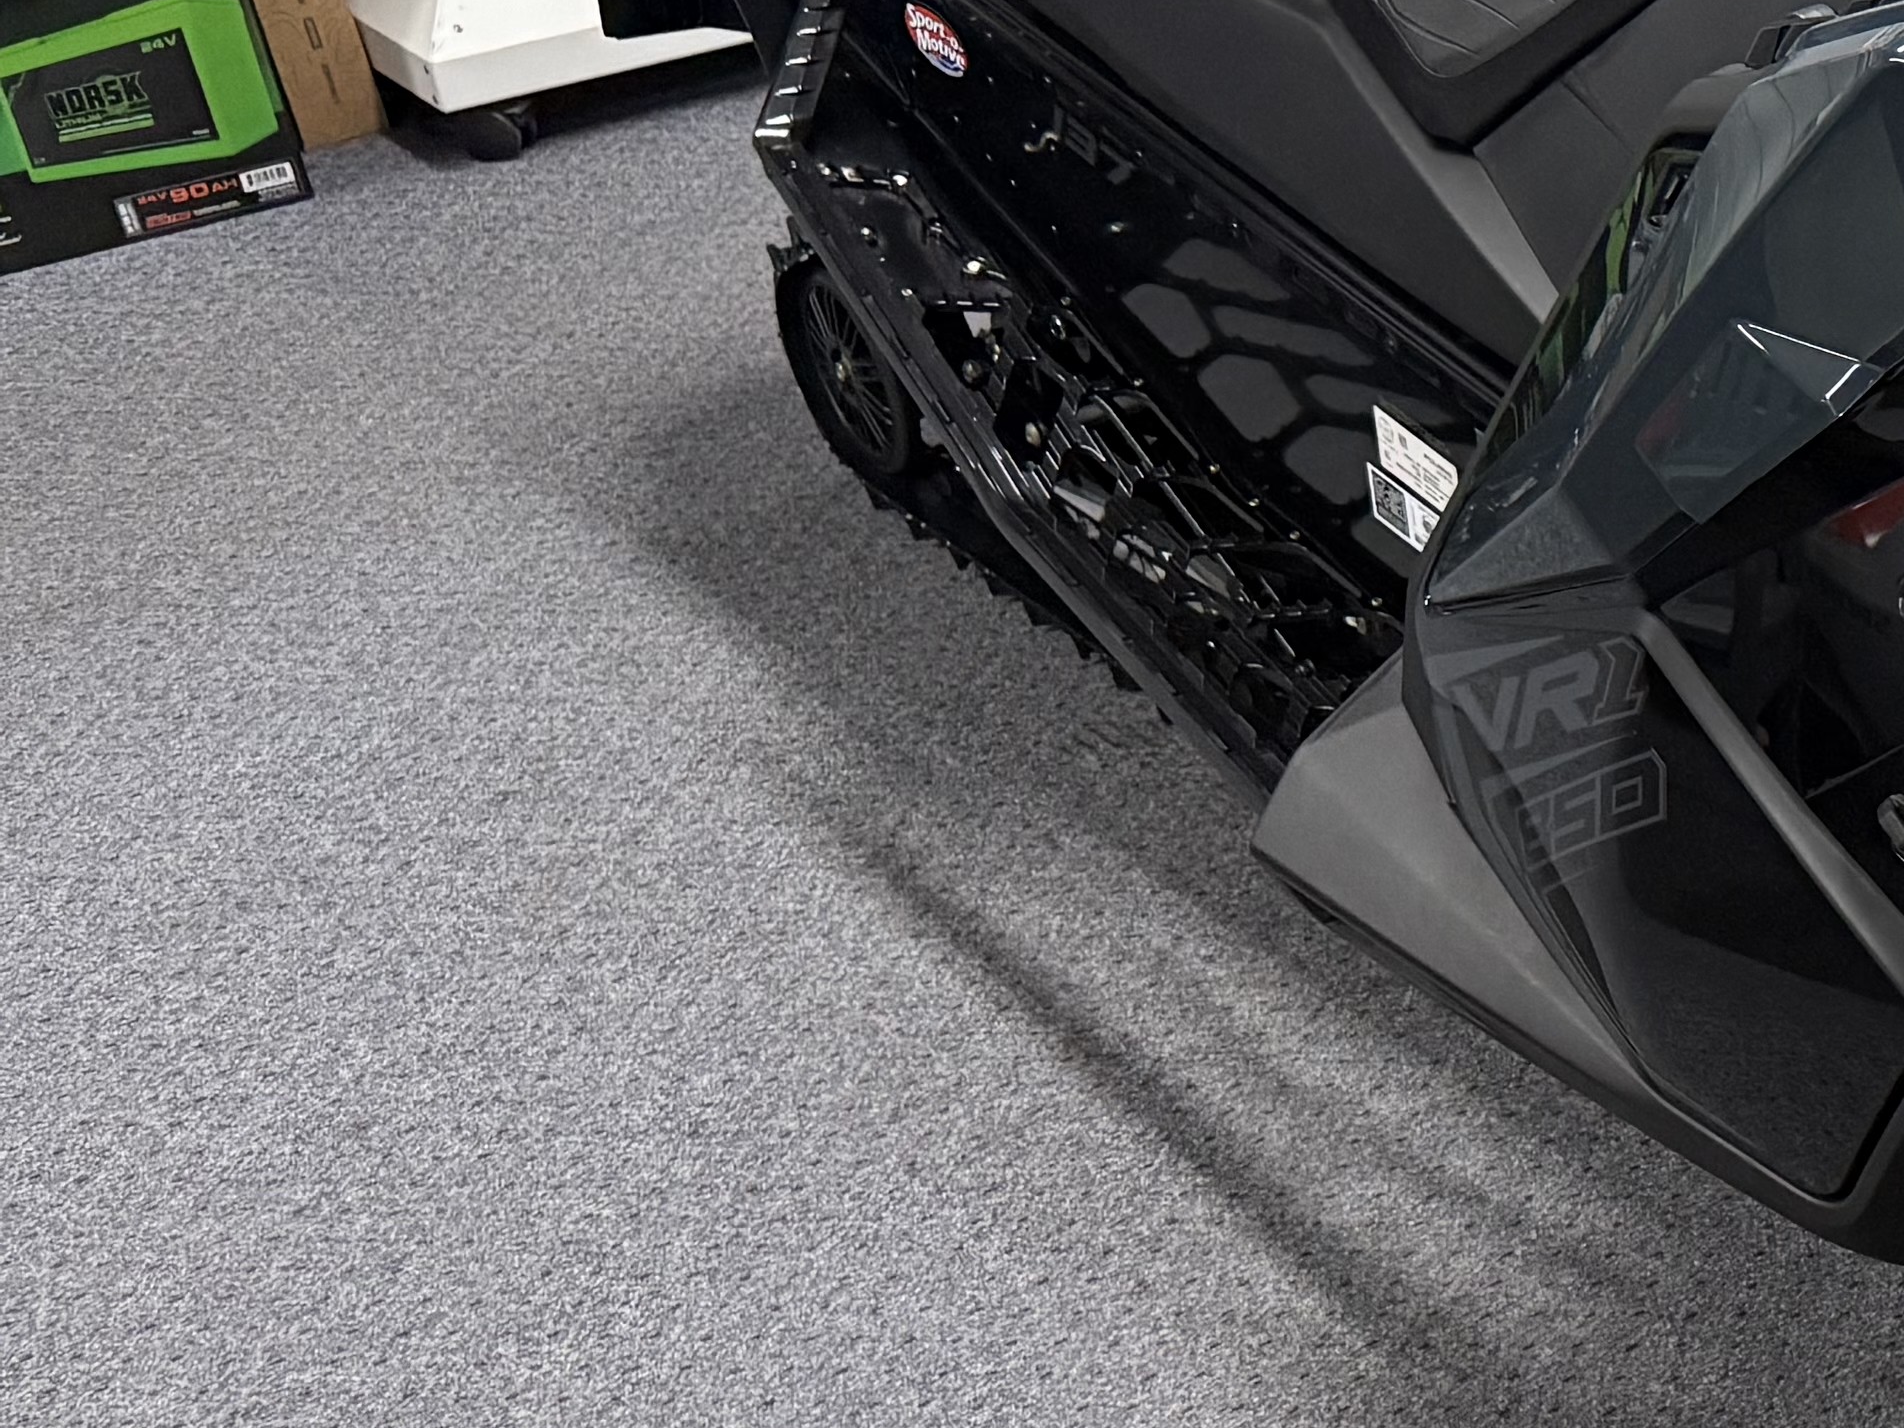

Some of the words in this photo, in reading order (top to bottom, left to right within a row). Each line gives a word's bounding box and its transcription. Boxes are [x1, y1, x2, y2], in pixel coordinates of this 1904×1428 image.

[141, 33, 178, 54] 24V
[45, 72, 149, 119] NORSK
[1450, 636, 1646, 752] VR1
